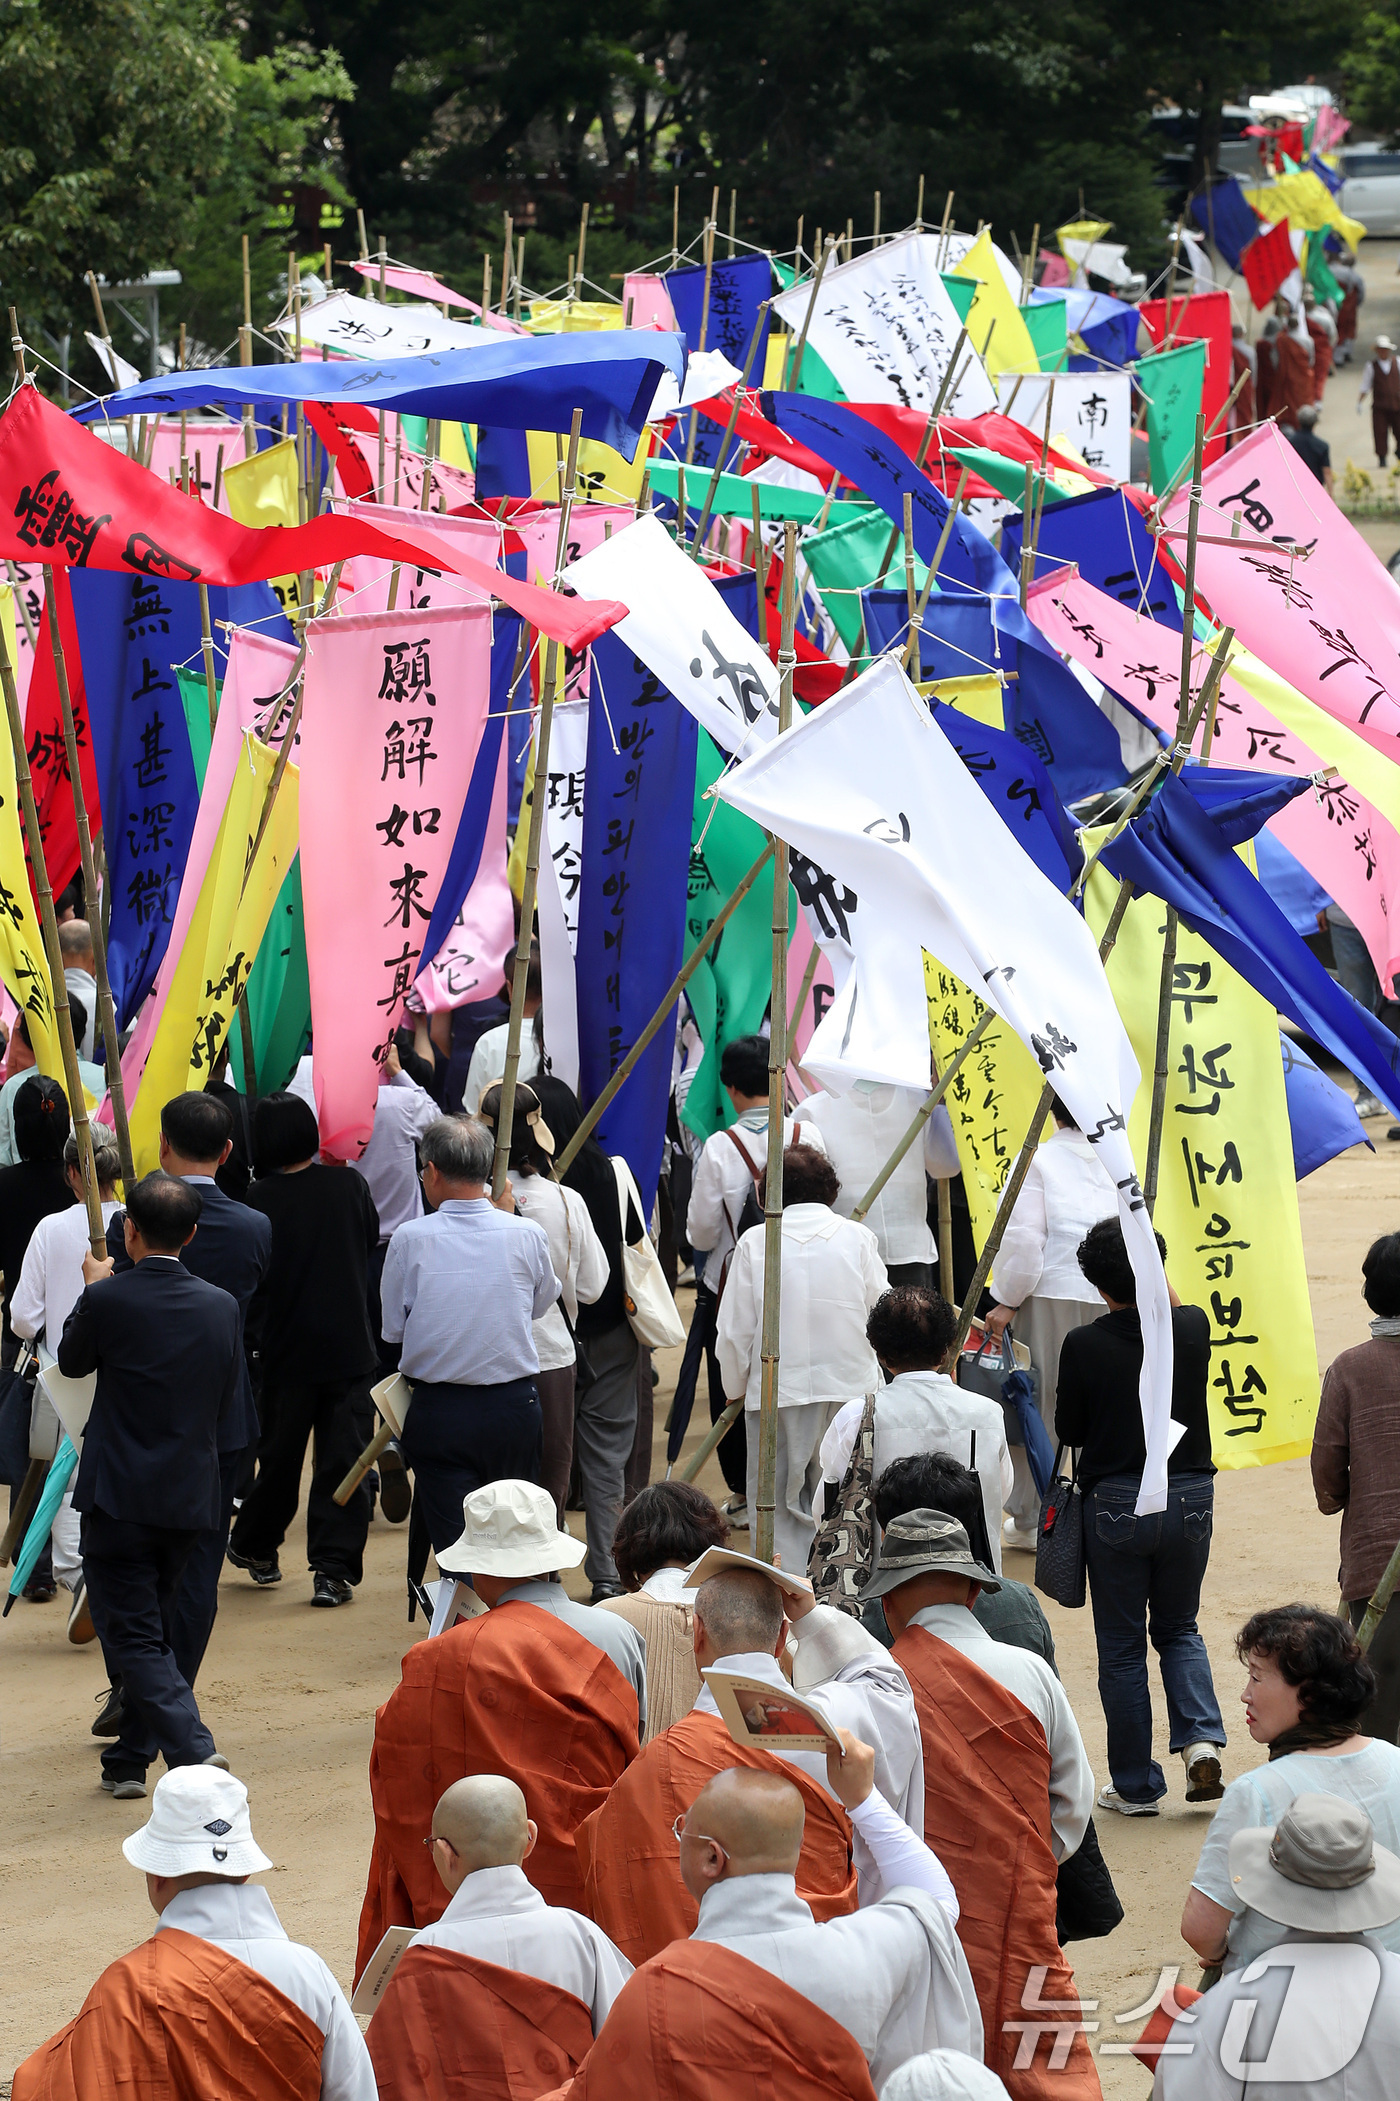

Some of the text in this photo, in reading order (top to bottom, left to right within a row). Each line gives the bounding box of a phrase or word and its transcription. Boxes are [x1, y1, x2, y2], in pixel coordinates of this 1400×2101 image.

[124, 576, 178, 983] 無上甚深微
[547, 767, 586, 945] 現今
